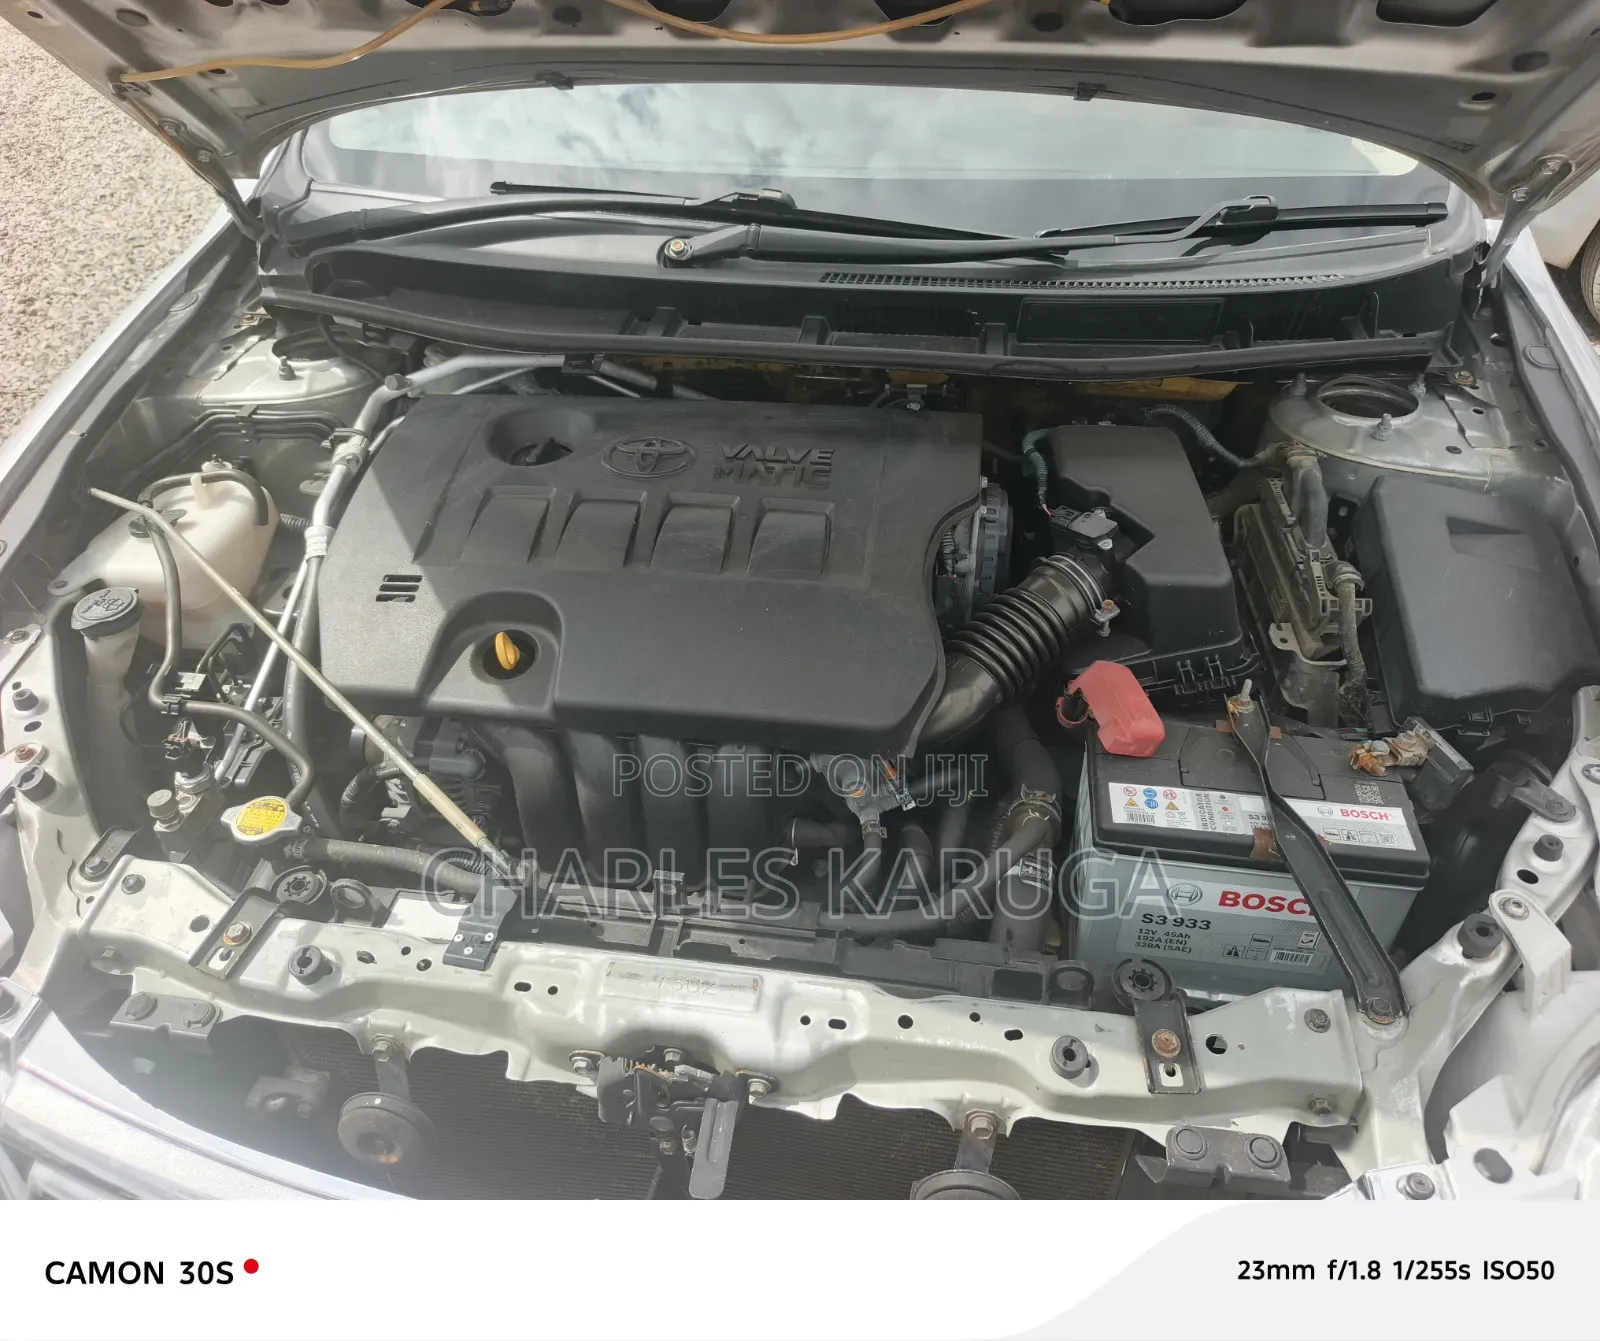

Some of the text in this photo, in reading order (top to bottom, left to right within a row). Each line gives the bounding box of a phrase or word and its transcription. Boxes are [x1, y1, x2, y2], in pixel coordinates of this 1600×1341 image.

[717, 443, 834, 466] VALVE
[712, 462, 832, 489] MATIC
[1196, 793, 1209, 830] INDICATOR
[1204, 793, 1216, 830] CONDITION
[1340, 808, 1388, 820] BOSCH
[1218, 890, 1316, 916] BOSC
[1141, 913, 1212, 930] S3 933
[1137, 928, 1191, 940] 12V 45Ah
[1137, 935, 1187, 946] 192A (EN)
[1135, 941, 1192, 954] 328A (SAE)
